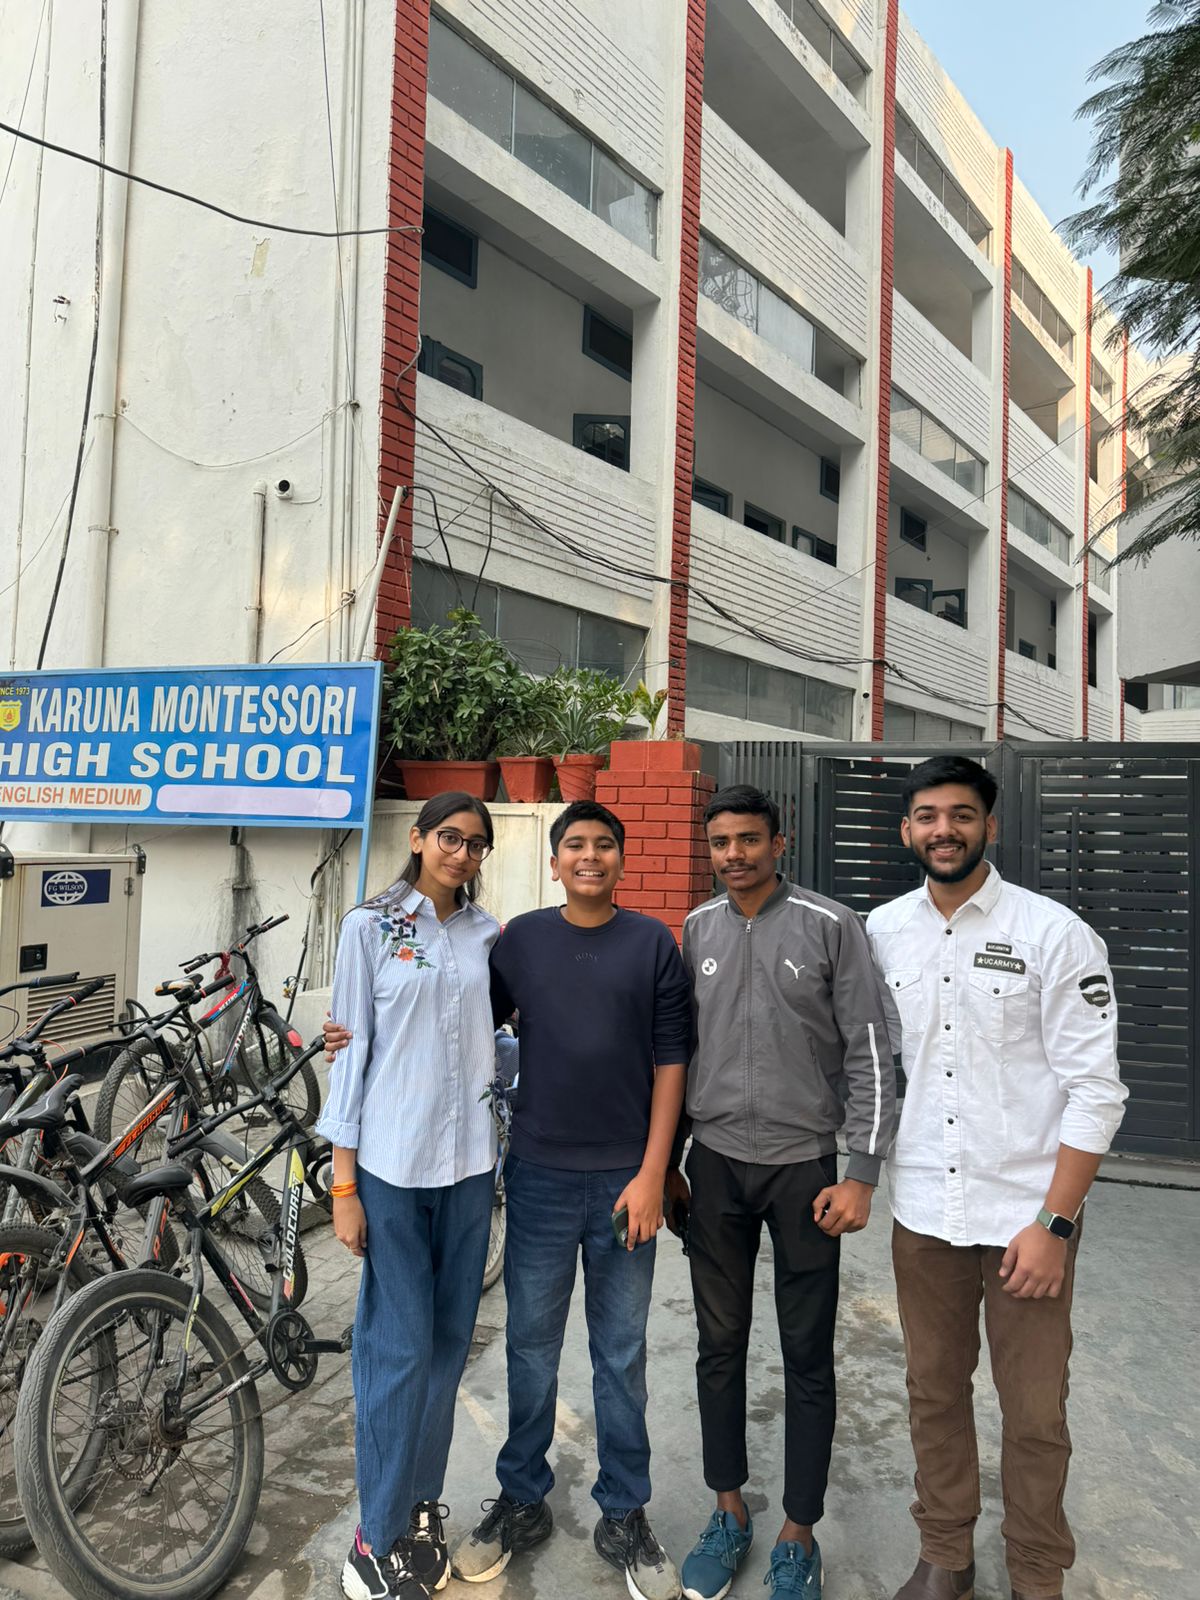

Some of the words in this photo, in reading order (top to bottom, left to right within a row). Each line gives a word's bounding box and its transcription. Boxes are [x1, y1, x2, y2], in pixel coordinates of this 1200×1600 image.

[0, 687, 14, 695] NCE
[15, 686, 30, 695] 1973
[28, 687, 140, 733] KARUNA
[150, 684, 357, 735] MONTESSORI
[0, 741, 111, 777] HIGH
[130, 741, 356, 783] SCHOOL
[0, 786, 64, 803] NGLISH
[69, 787, 142, 805] MEDIUM
[983, 957, 1015, 969] UCARMY
[282, 1171, 301, 1282] GOLDCOAST
